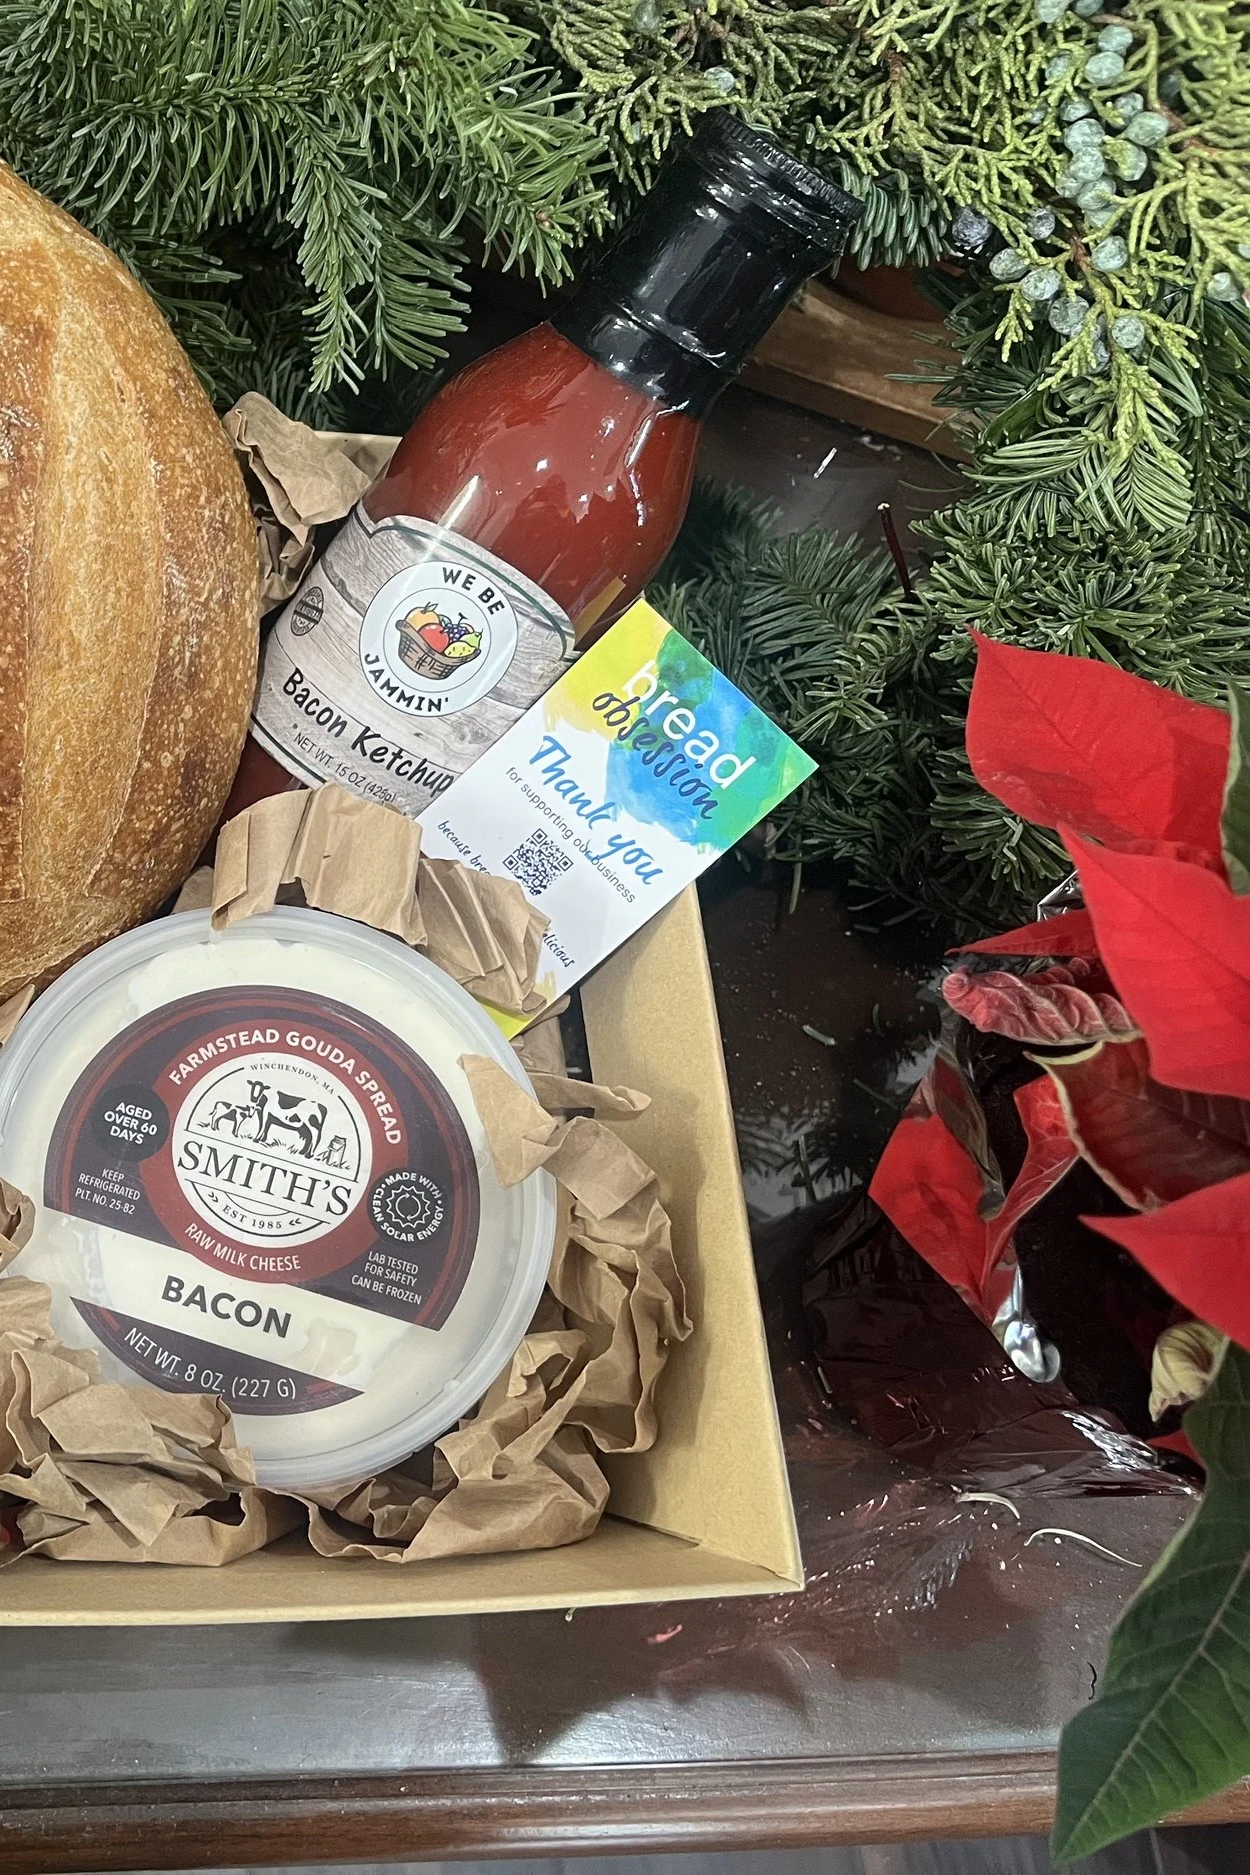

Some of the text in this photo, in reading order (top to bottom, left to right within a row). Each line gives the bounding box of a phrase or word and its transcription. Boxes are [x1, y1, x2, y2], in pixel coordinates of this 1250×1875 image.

[442, 566, 505, 616] WE BE
[364, 653, 449, 712] JAMMIN'
[283, 667, 454, 797] Bacon Ketchup
[621, 659, 757, 790] bread
[293, 732, 317, 752] NET
[315, 748, 335, 768] WT.
[335, 763, 347, 777] 15
[348, 771, 366, 788] OZ
[593, 692, 719, 820] obsession
[505, 766, 636, 903] for supporting our business
[529, 735, 664, 885] Thank you
[437, 820, 471, 857] because
[168, 1028, 402, 1145] FARMSTEAD GOUDA SPREAD
[250, 1063, 335, 1096] WINCHENDON, MA
[104, 1110, 158, 1136] OVER 60
[110, 1125, 144, 1145] DAYS
[115, 1102, 152, 1121] AGED
[75, 1187, 91, 1201] PLT.
[92, 1193, 108, 1207] NO.
[78, 1173, 141, 1201] REFRIGERATED
[102, 1168, 125, 1182] KEEP
[177, 1140, 352, 1216] SMITH'S
[384, 1171, 443, 1199] MADE WITH
[222, 1204, 283, 1230] EST 1985
[372, 1188, 445, 1242] CLEAN SOLAR ENERGY
[184, 1222, 302, 1272] RAW MILK CHEESE
[368, 1251, 419, 1275] LAB TESTED
[351, 1274, 422, 1305] CAN BE FROZEN
[364, 1263, 418, 1287] FOR SAFETY
[161, 1274, 292, 1339] BACON
[124, 1327, 297, 1400] NET WT. 8 OZ. (227 G)
